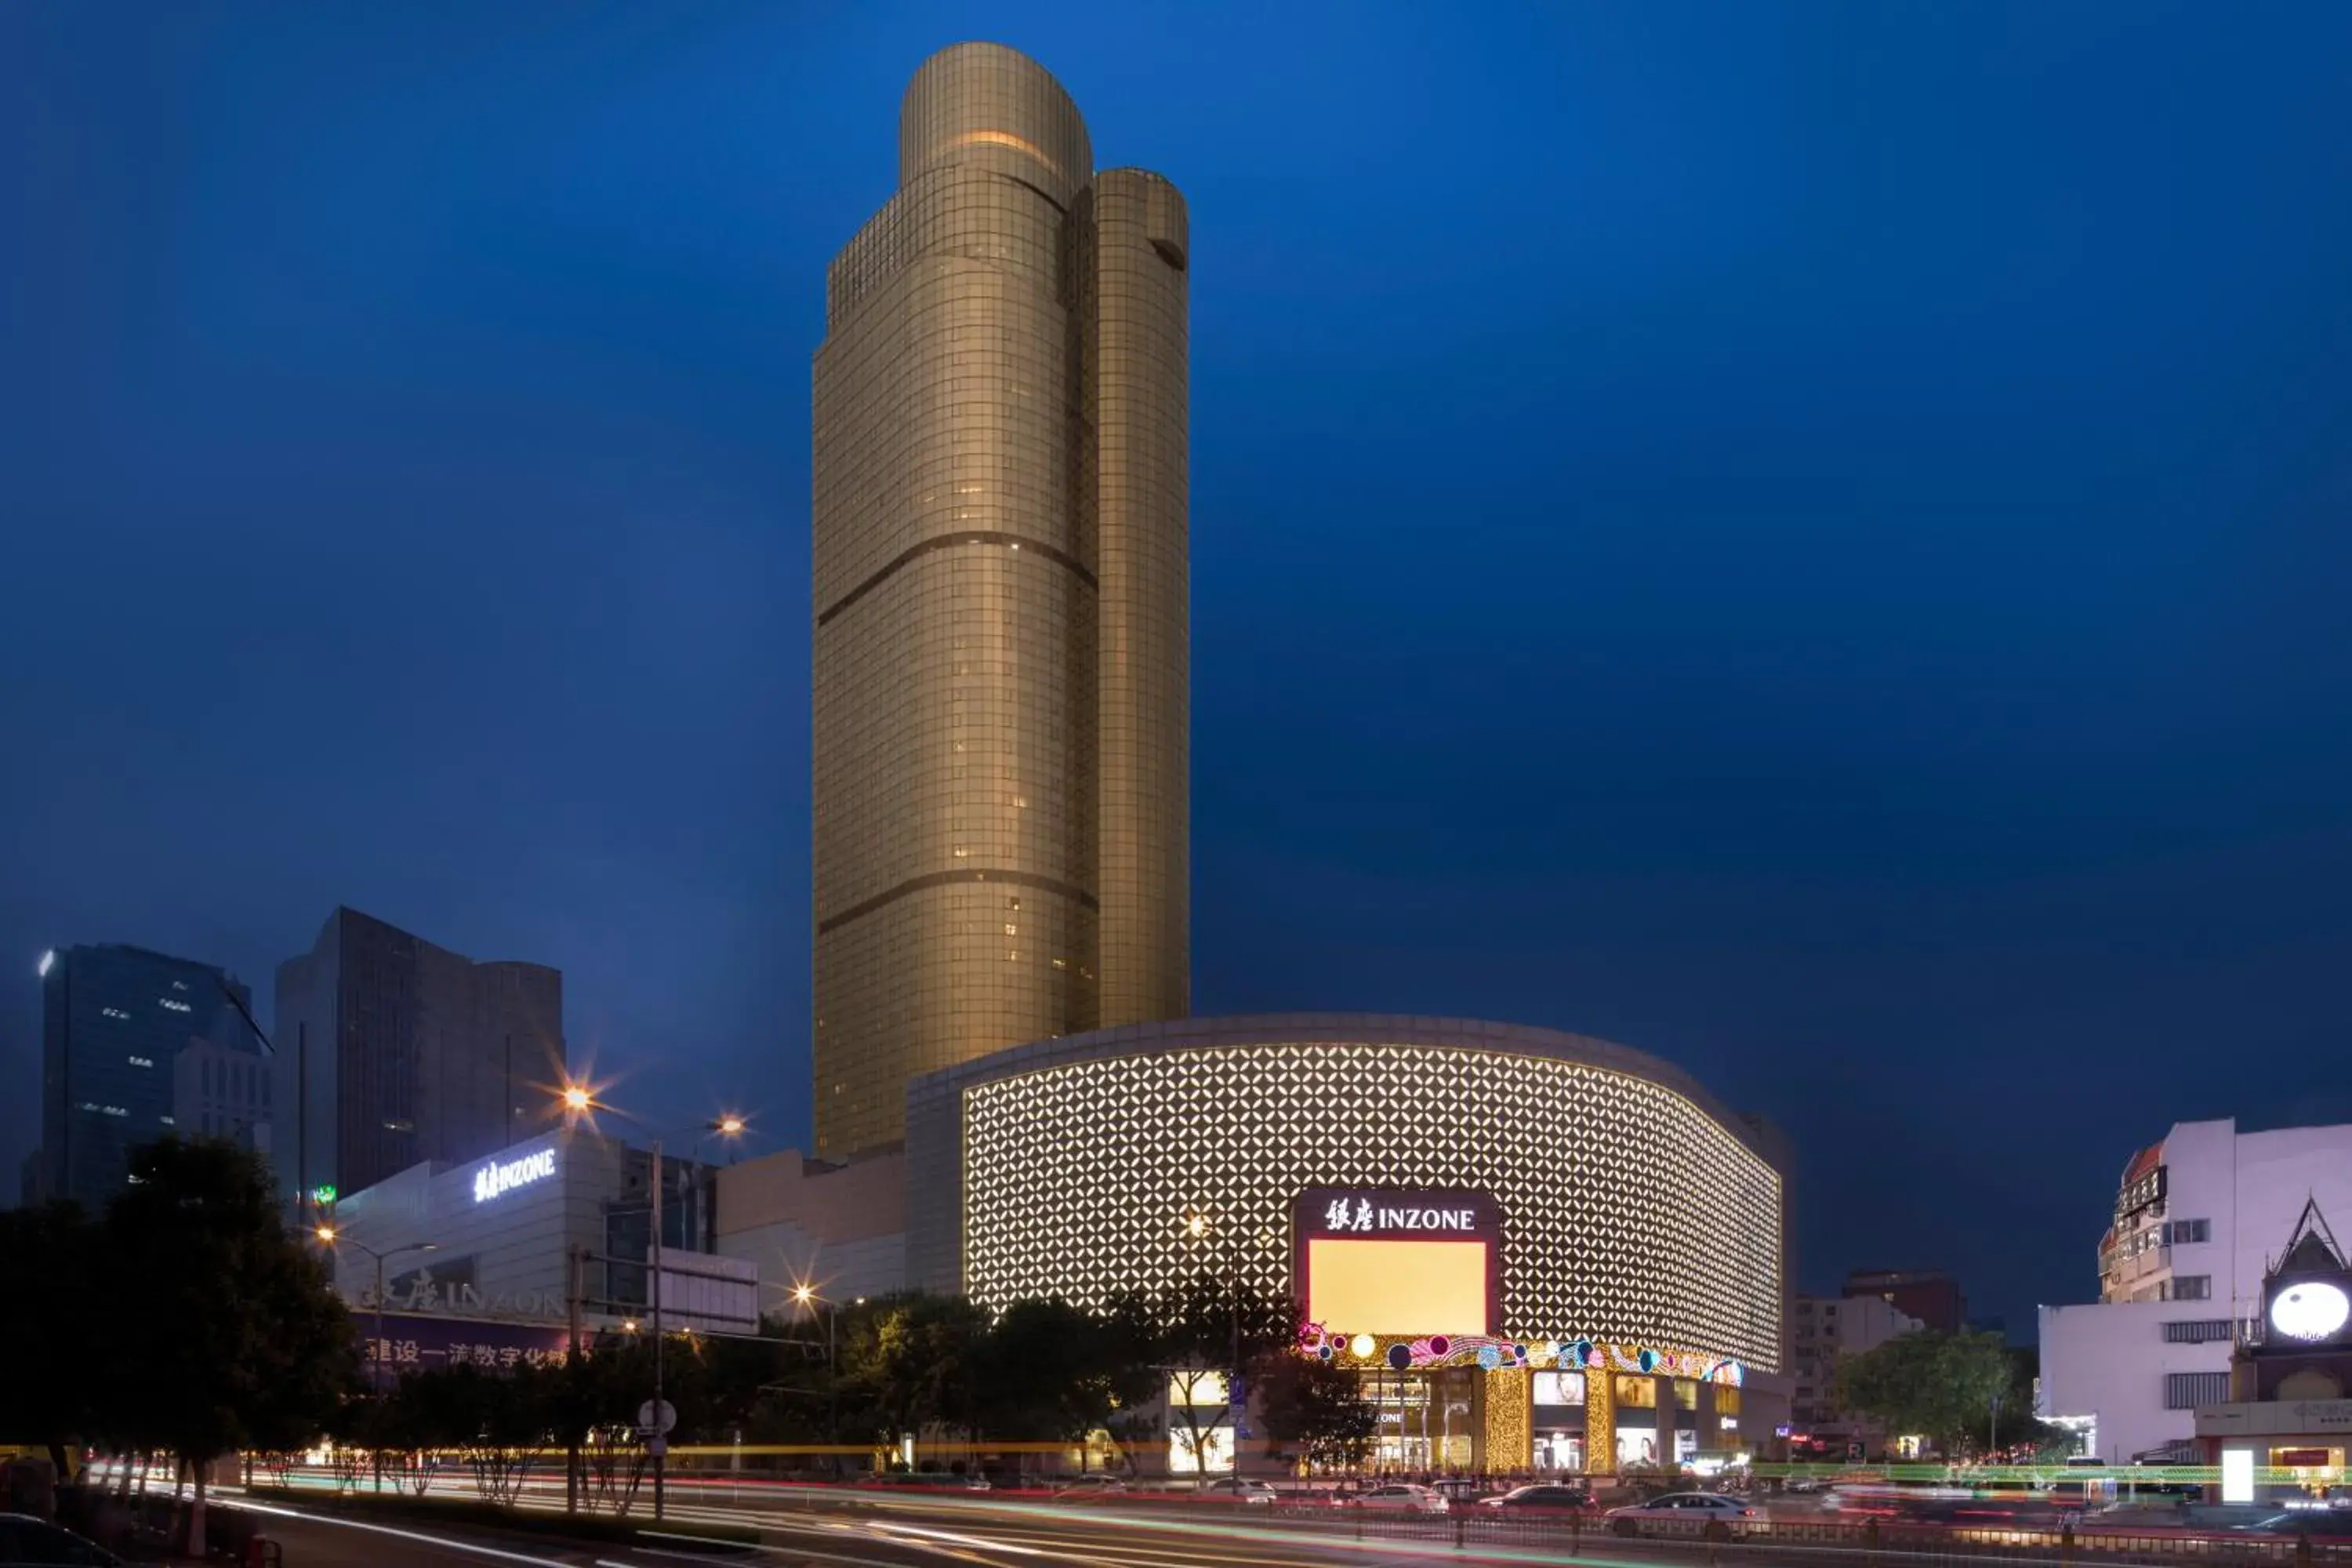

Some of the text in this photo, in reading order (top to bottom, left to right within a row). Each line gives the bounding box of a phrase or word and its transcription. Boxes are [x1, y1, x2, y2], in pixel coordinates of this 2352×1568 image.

[499, 1149, 555, 1192] INZONE
[1379, 1208, 1475, 1230] INZONE
[446, 1280, 566, 1317] INZON
